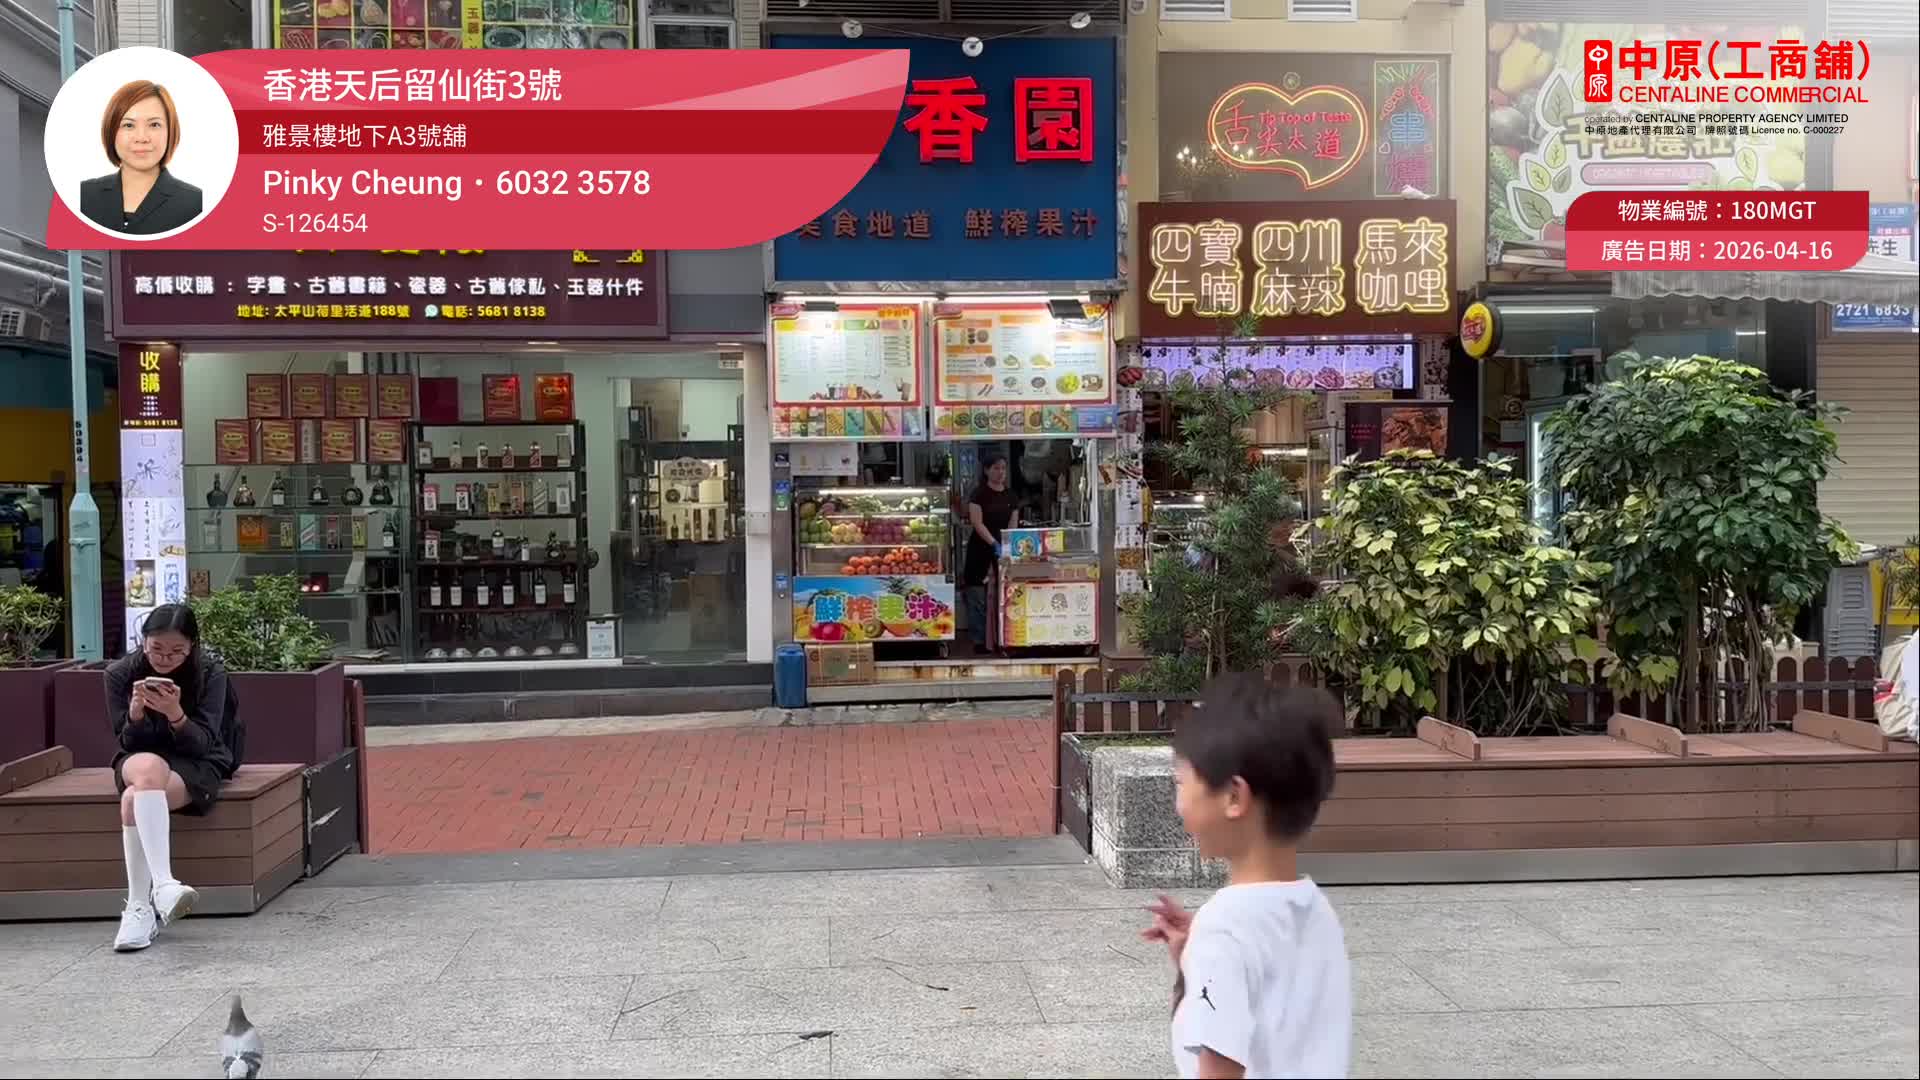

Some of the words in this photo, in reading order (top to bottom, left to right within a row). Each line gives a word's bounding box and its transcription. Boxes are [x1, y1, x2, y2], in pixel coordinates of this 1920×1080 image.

[1259, 111, 1276, 126] Tip
[1280, 112, 1300, 125] Top
[1304, 111, 1316, 122] of
[964, 208, 1098, 238] 鮮榨果汁
[1156, 221, 1238, 268] 四寶
[1259, 221, 1338, 263] 四川
[1362, 221, 1444, 265] 馬來
[1153, 269, 1238, 312] 牛腩
[1264, 268, 1337, 310] 麻辣
[1361, 269, 1445, 309] 咖哩
[477, 305, 509, 316] 5681
[513, 306, 546, 317] 8138
